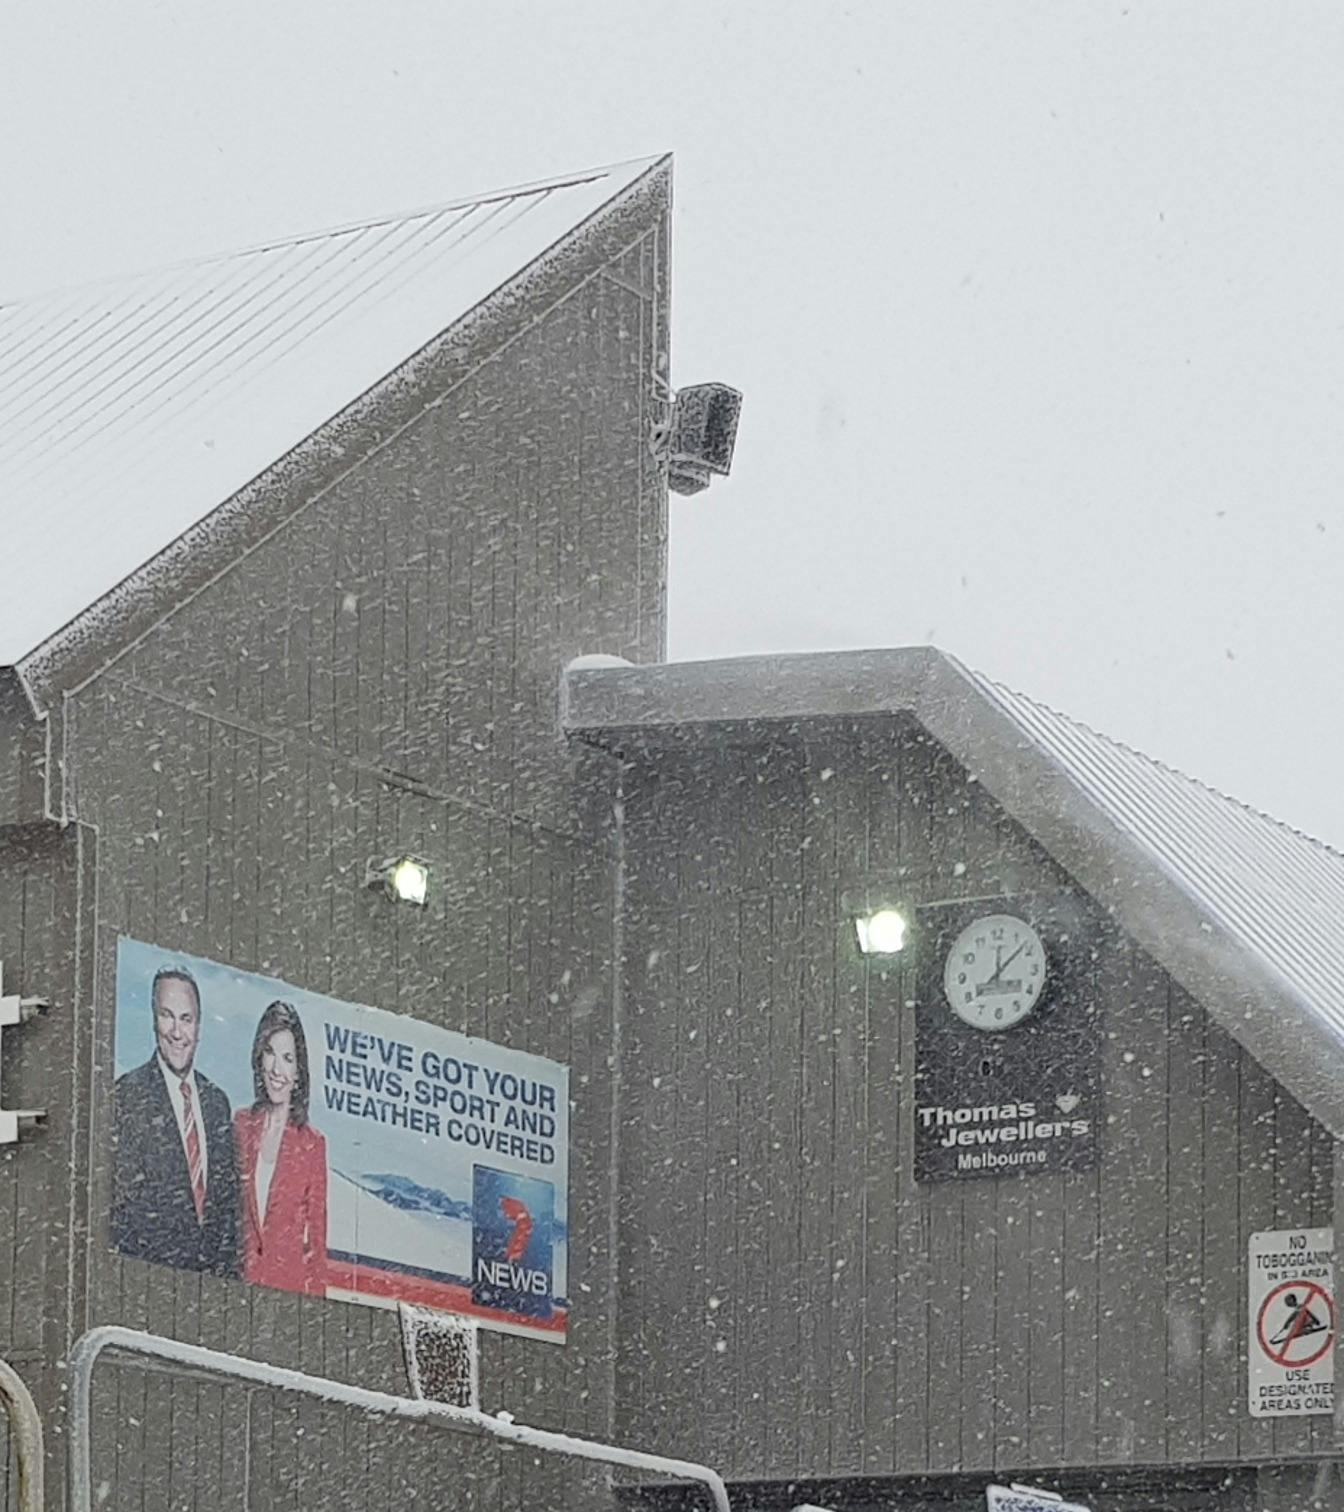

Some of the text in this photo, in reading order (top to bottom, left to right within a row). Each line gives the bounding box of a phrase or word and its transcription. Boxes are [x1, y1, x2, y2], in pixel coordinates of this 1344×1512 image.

[324, 1023, 556, 1113] WE'VE GOT YOUR
[325, 1055, 556, 1139] NEWS, SPORT AND
[324, 1085, 555, 1165] WEATHER COVERED
[917, 1102, 1037, 1127] Thomas
[941, 1119, 1090, 1147] Jewellers
[958, 1150, 1046, 1170] Melbourne
[1289, 1235, 1307, 1250] NO
[477, 1258, 547, 1295] NEWS
[1285, 1369, 1311, 1381] USE
